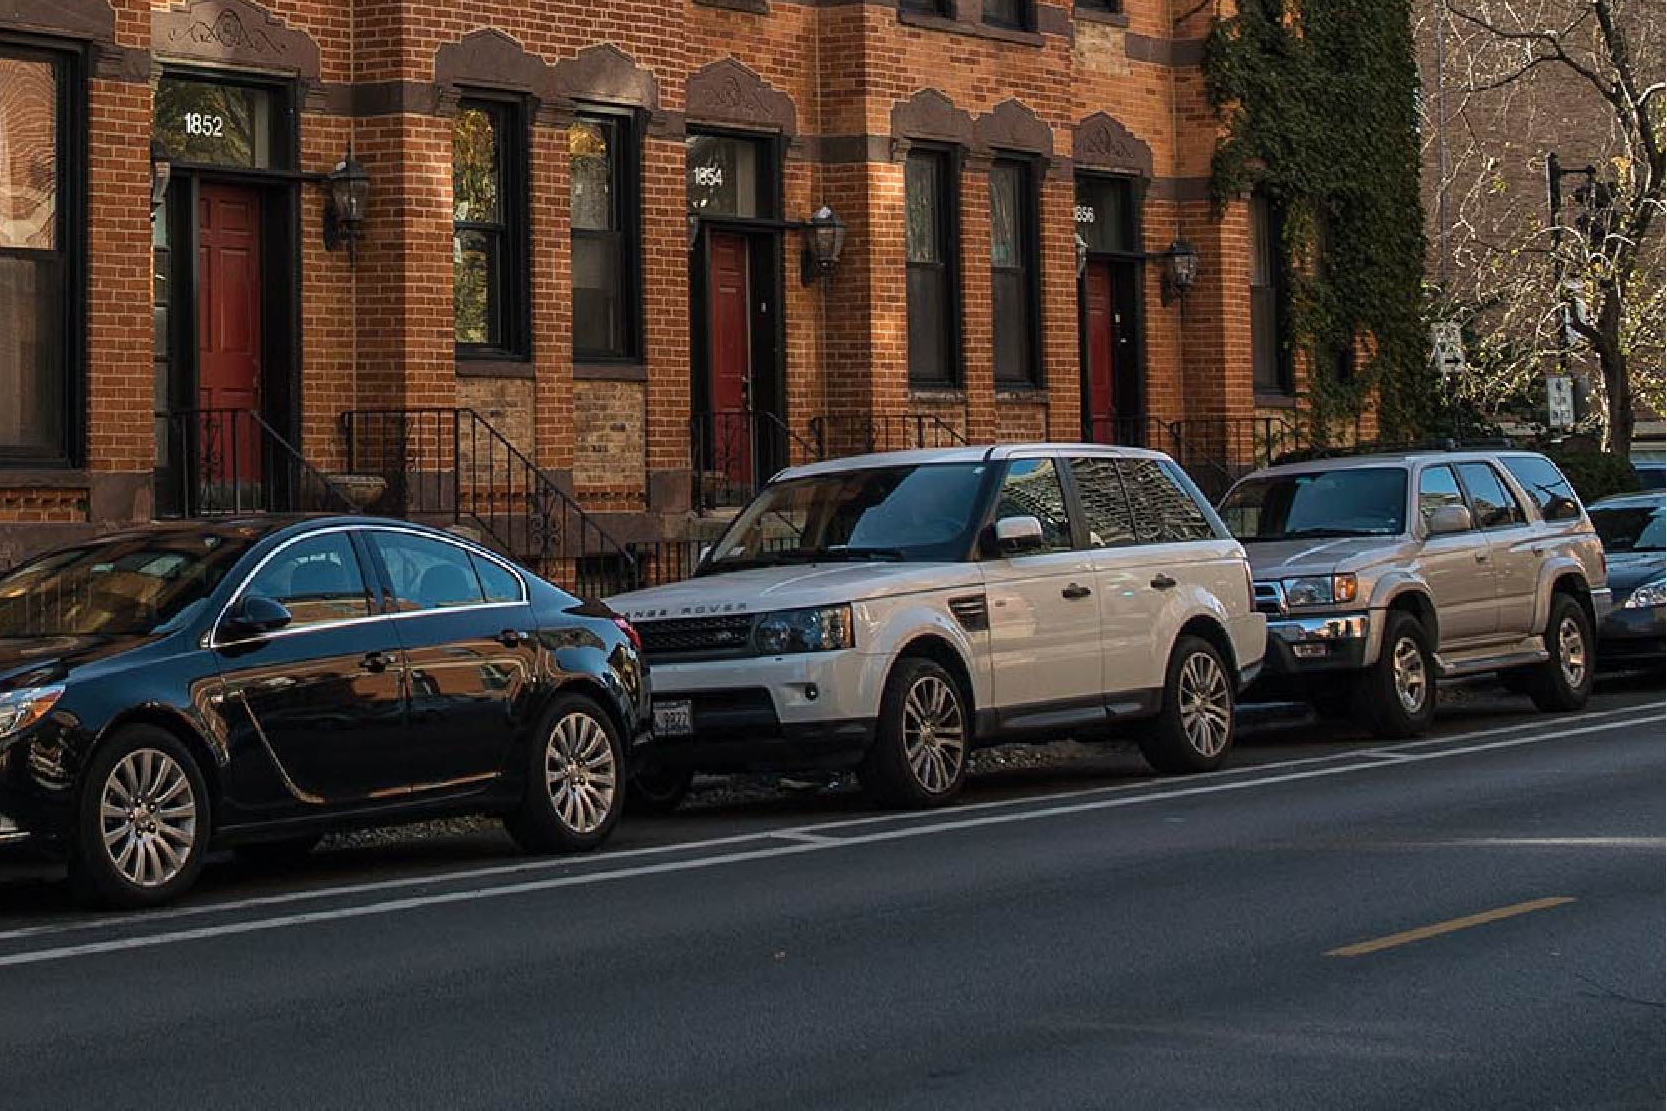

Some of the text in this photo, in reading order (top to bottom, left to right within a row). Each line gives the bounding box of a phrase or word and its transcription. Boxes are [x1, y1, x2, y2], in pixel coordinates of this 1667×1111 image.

[184, 112, 223, 138] 1852
[693, 167, 723, 186] 1854
[624, 602, 746, 618] ANGE ROVER
